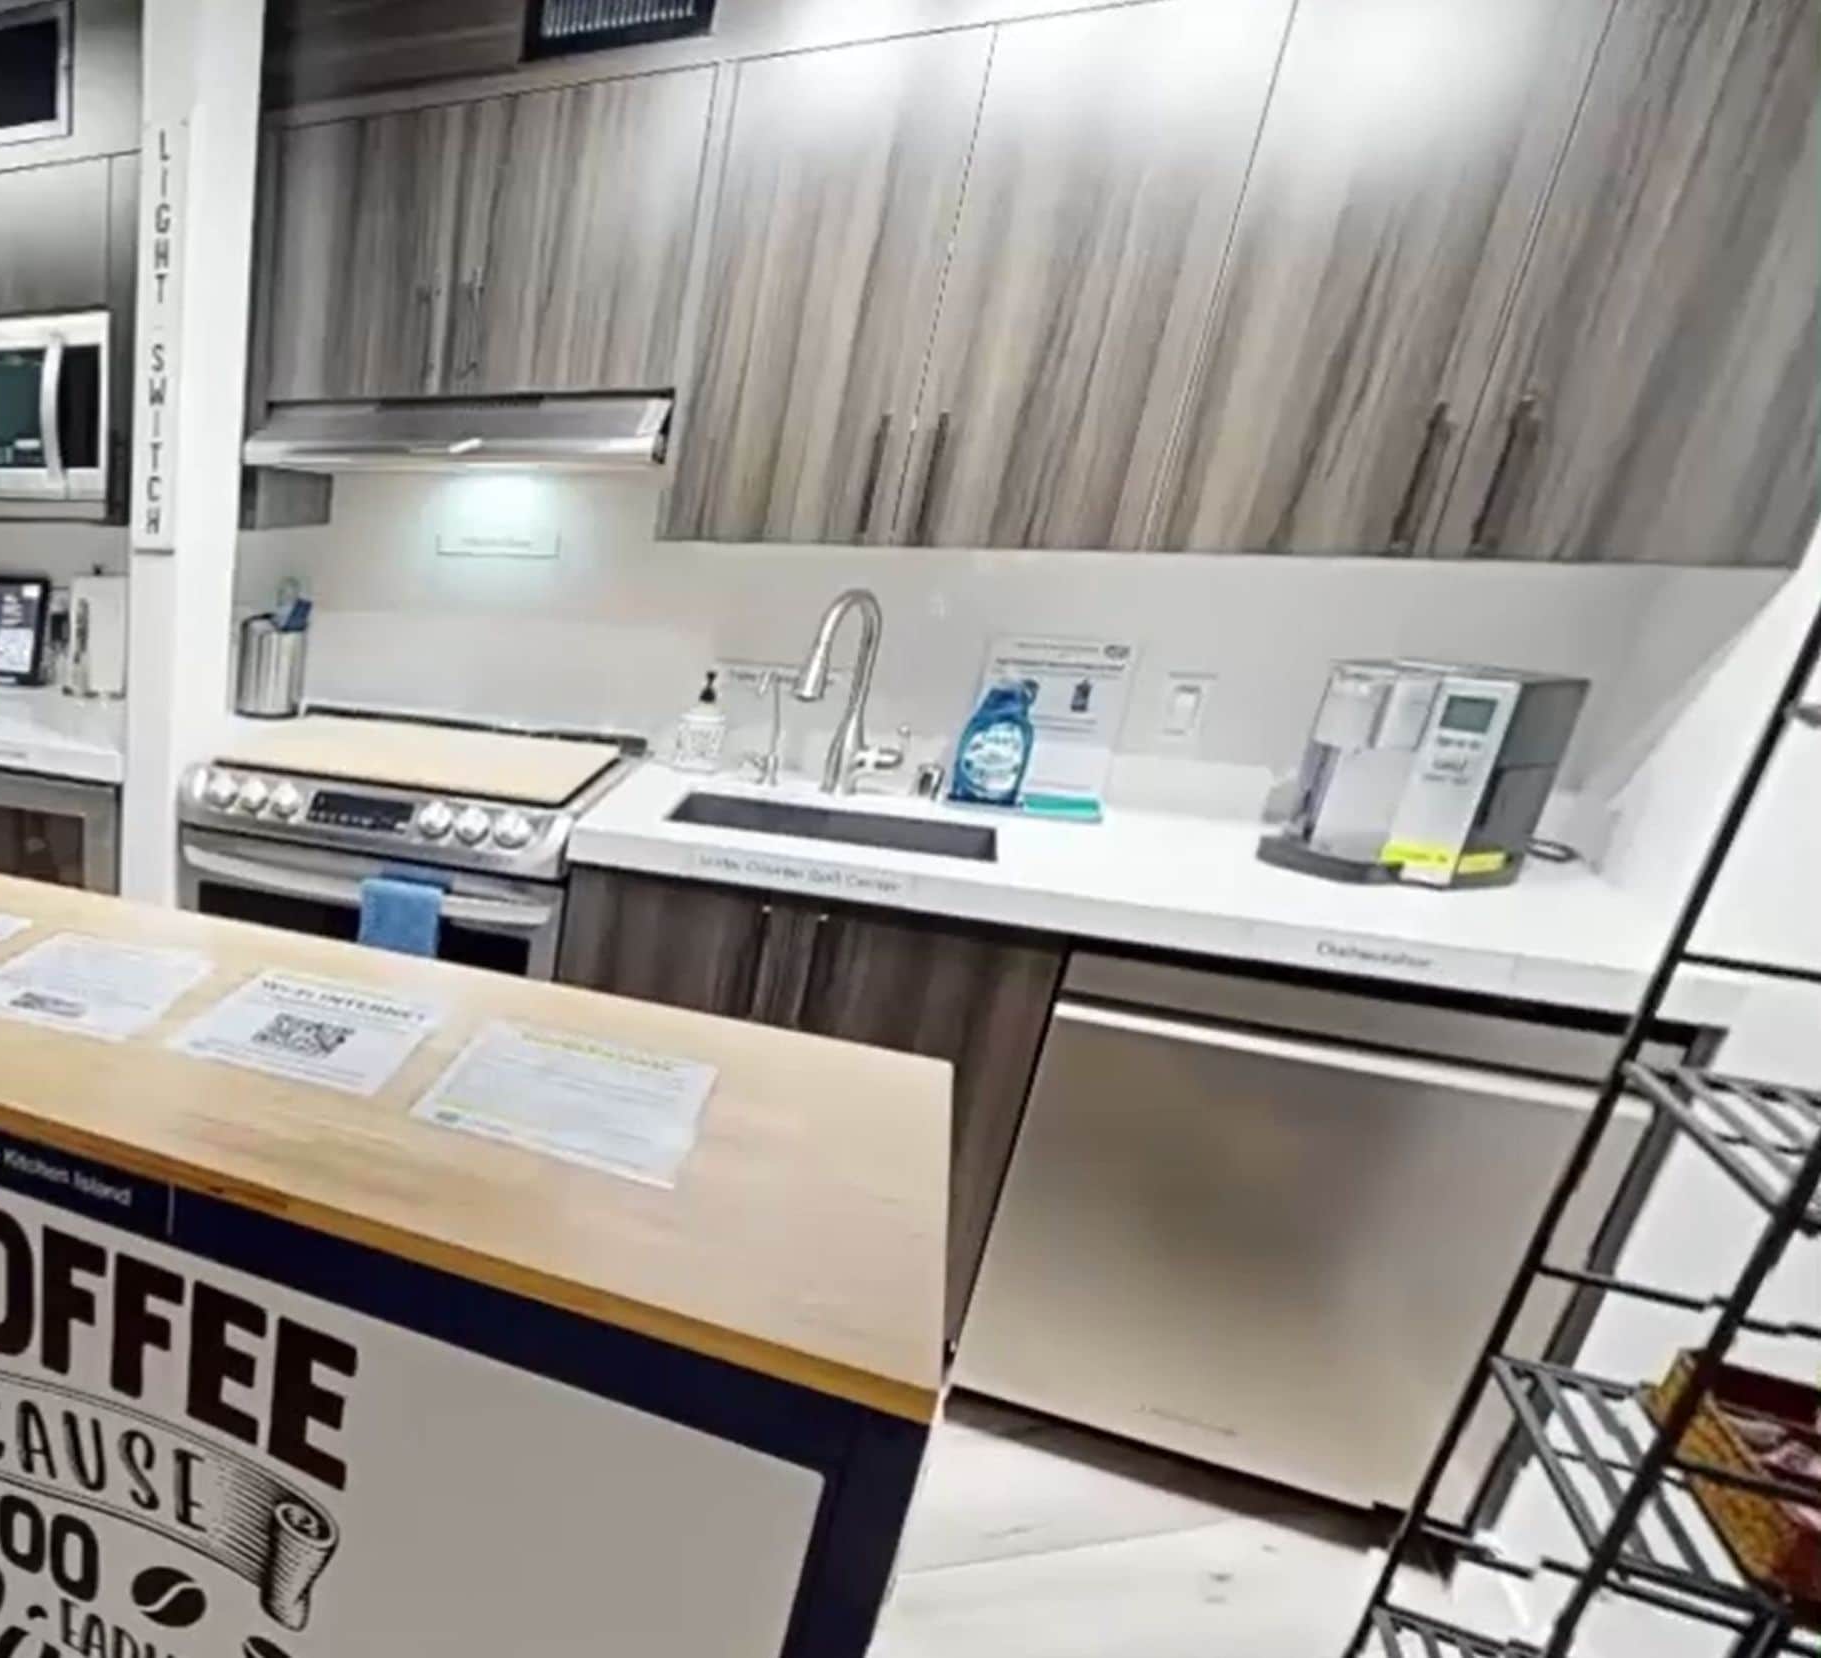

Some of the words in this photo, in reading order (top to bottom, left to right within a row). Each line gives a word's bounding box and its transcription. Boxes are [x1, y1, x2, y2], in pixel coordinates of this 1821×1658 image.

[153, 128, 172, 304] LIGHT
[145, 342, 168, 535] SWITCH
[2, 1147, 71, 1185] Kitchen
[73, 1169, 133, 1207] Island
